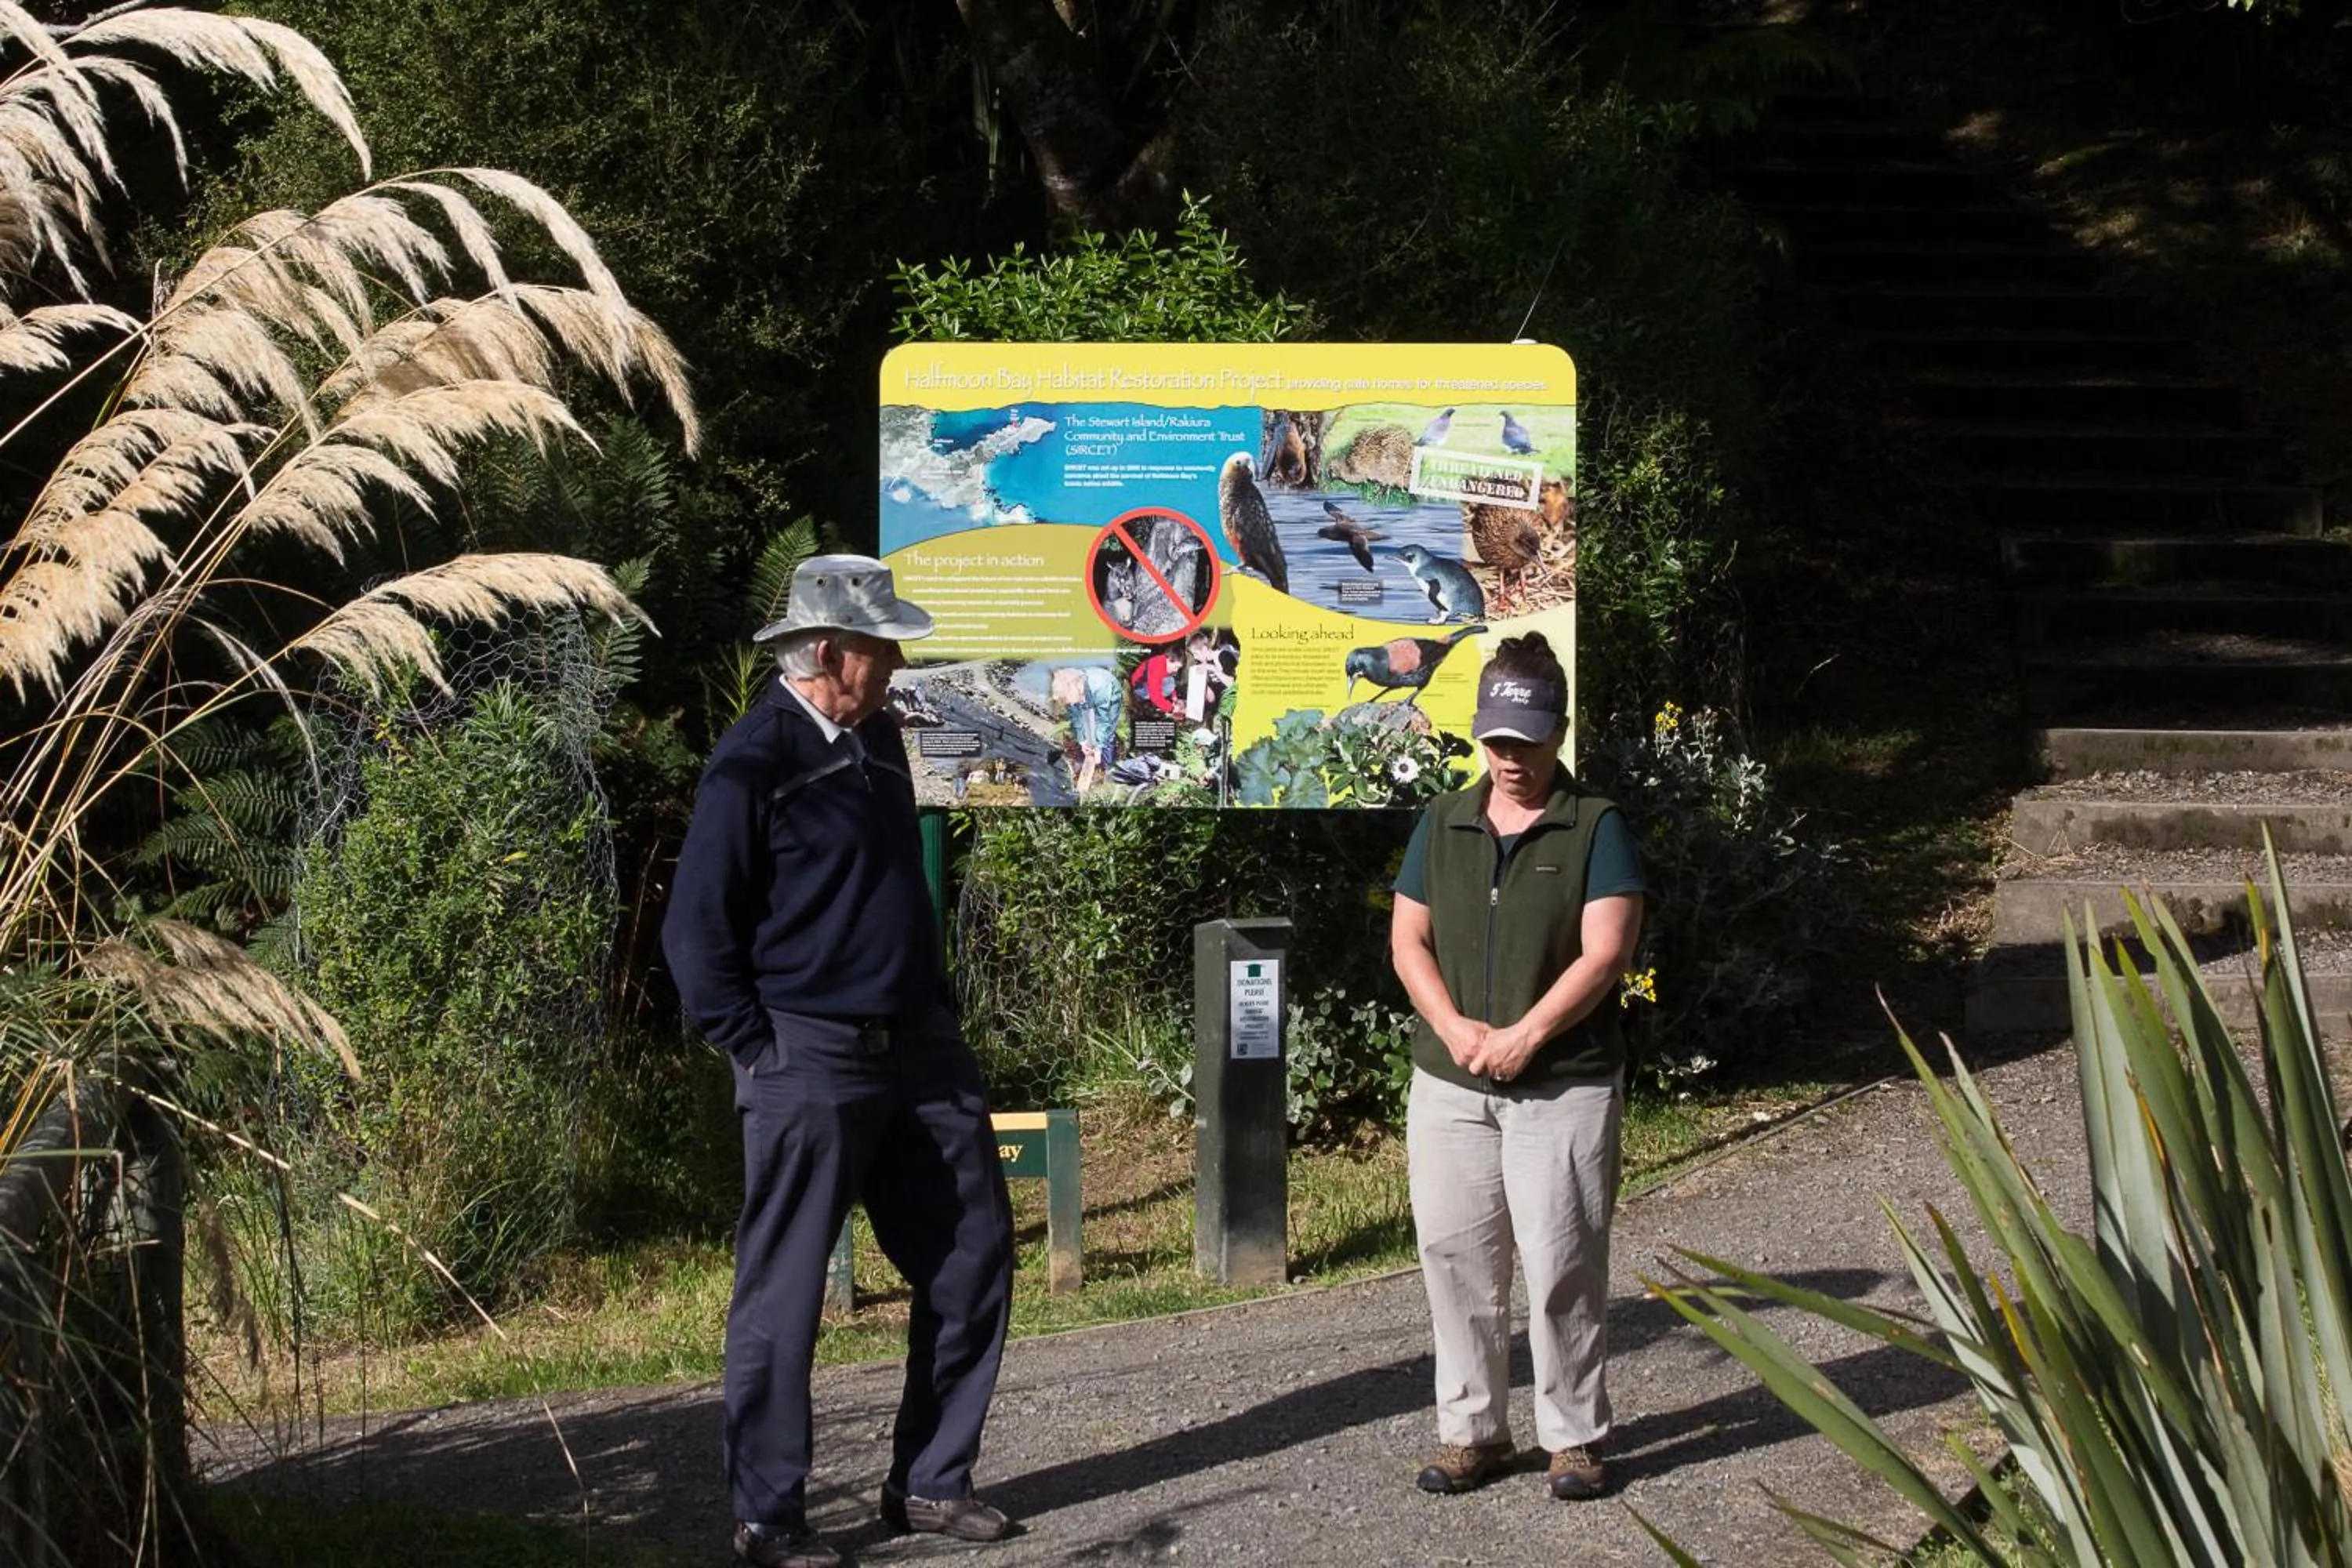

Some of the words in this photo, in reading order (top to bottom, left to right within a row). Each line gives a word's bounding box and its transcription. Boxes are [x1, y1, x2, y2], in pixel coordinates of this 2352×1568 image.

[905, 361, 992, 390] Halfmoon
[996, 366, 1033, 398] Bay
[1037, 361, 1105, 390] Habitat
[1109, 365, 1214, 390] Restoration
[1220, 368, 1285, 404] Project
[1287, 378, 1341, 392] providing
[1417, 378, 1431, 390] for
[1436, 378, 1499, 390] threatened
[1063, 414, 1086, 427] The
[1087, 416, 1130, 427] Stewart
[1131, 413, 1212, 428] Island/Rakiura
[1063, 431, 1124, 445] Community
[1127, 428, 1147, 441] and
[1149, 431, 1214, 442] Environment
[1218, 431, 1246, 442] Trust
[1065, 445, 1117, 456] (SIRCET)
[903, 550, 931, 566] The
[933, 554, 985, 574] project
[986, 553, 998, 566] in
[1001, 553, 1044, 567] action
[1251, 622, 1309, 644] Looking
[1310, 622, 1354, 640] ahead
[1500, 681, 1532, 697] Terre
[998, 1143, 1023, 1163] ay
